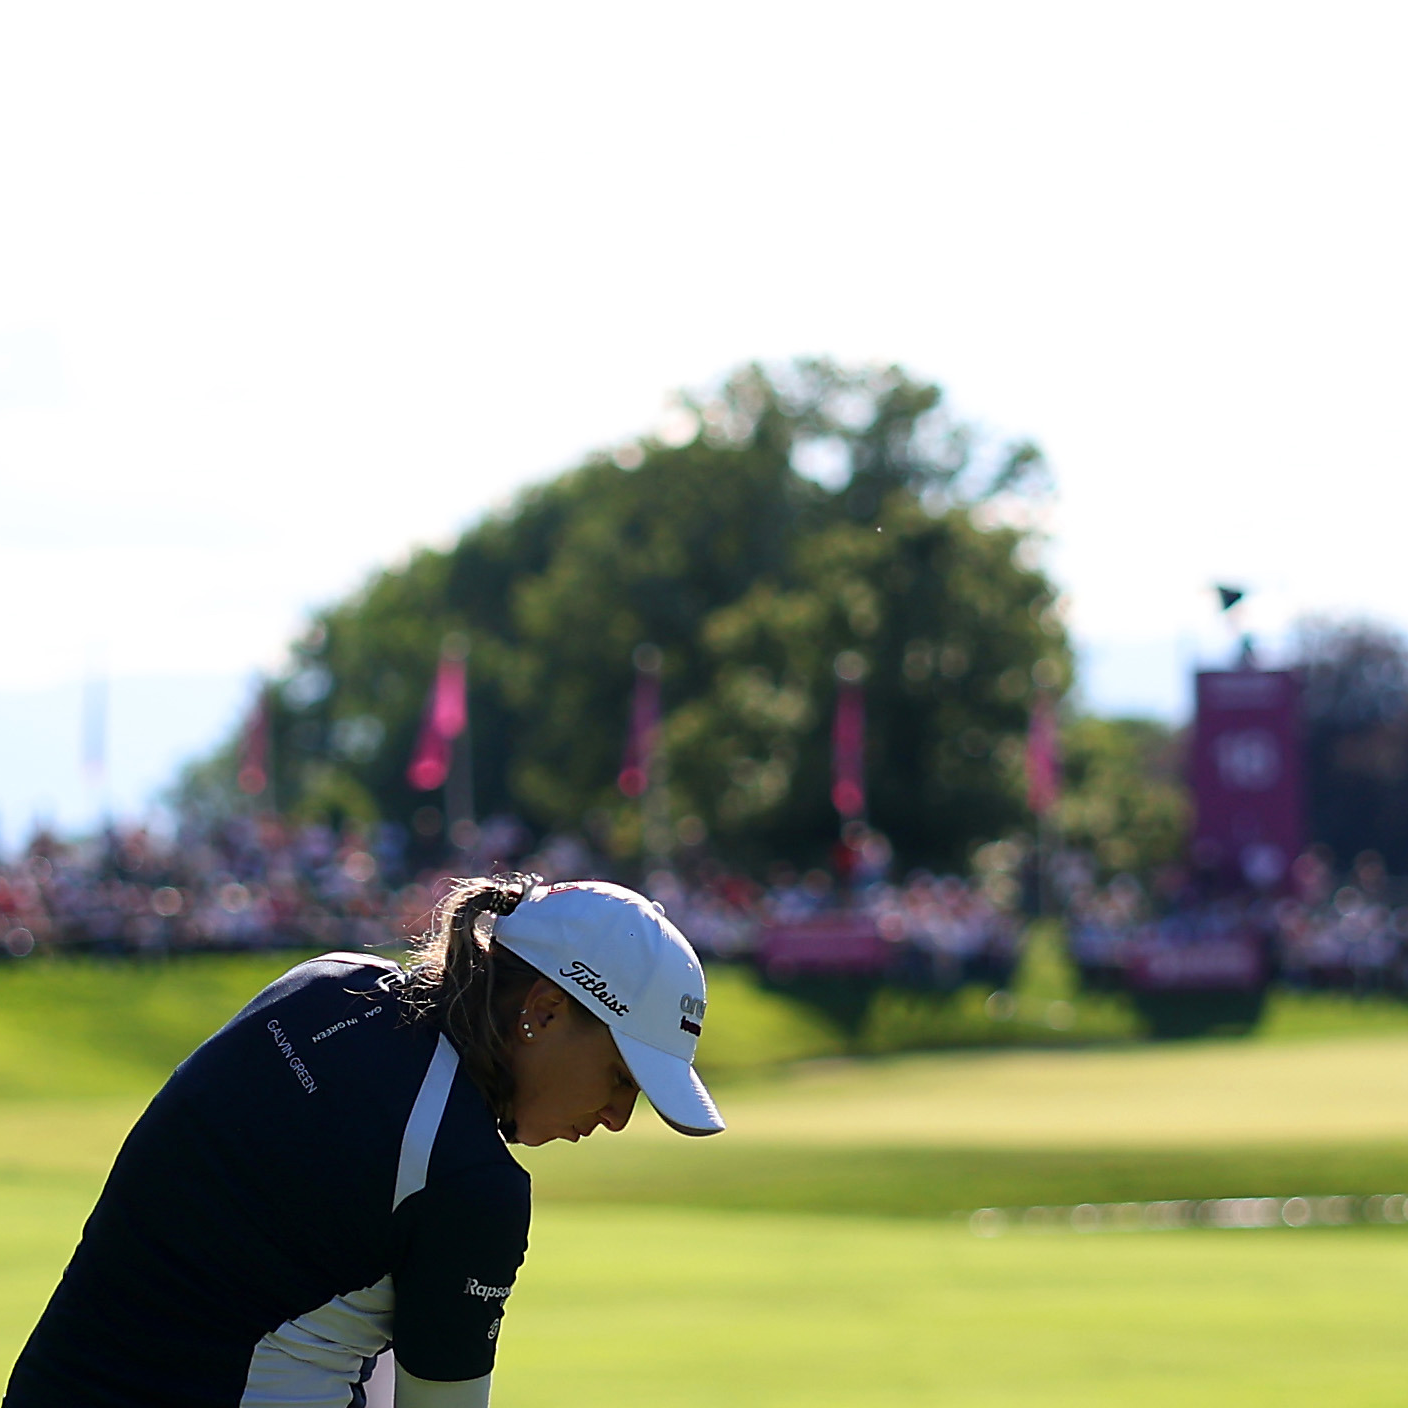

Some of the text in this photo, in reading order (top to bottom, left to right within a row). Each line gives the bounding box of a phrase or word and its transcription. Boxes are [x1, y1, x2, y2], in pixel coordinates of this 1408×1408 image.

[559, 960, 630, 1017] Titleist
[311, 1021, 347, 1044] GREEN
[266, 1019, 318, 1094] GALVIN GREEN
[463, 1276, 511, 1302] Rapso
